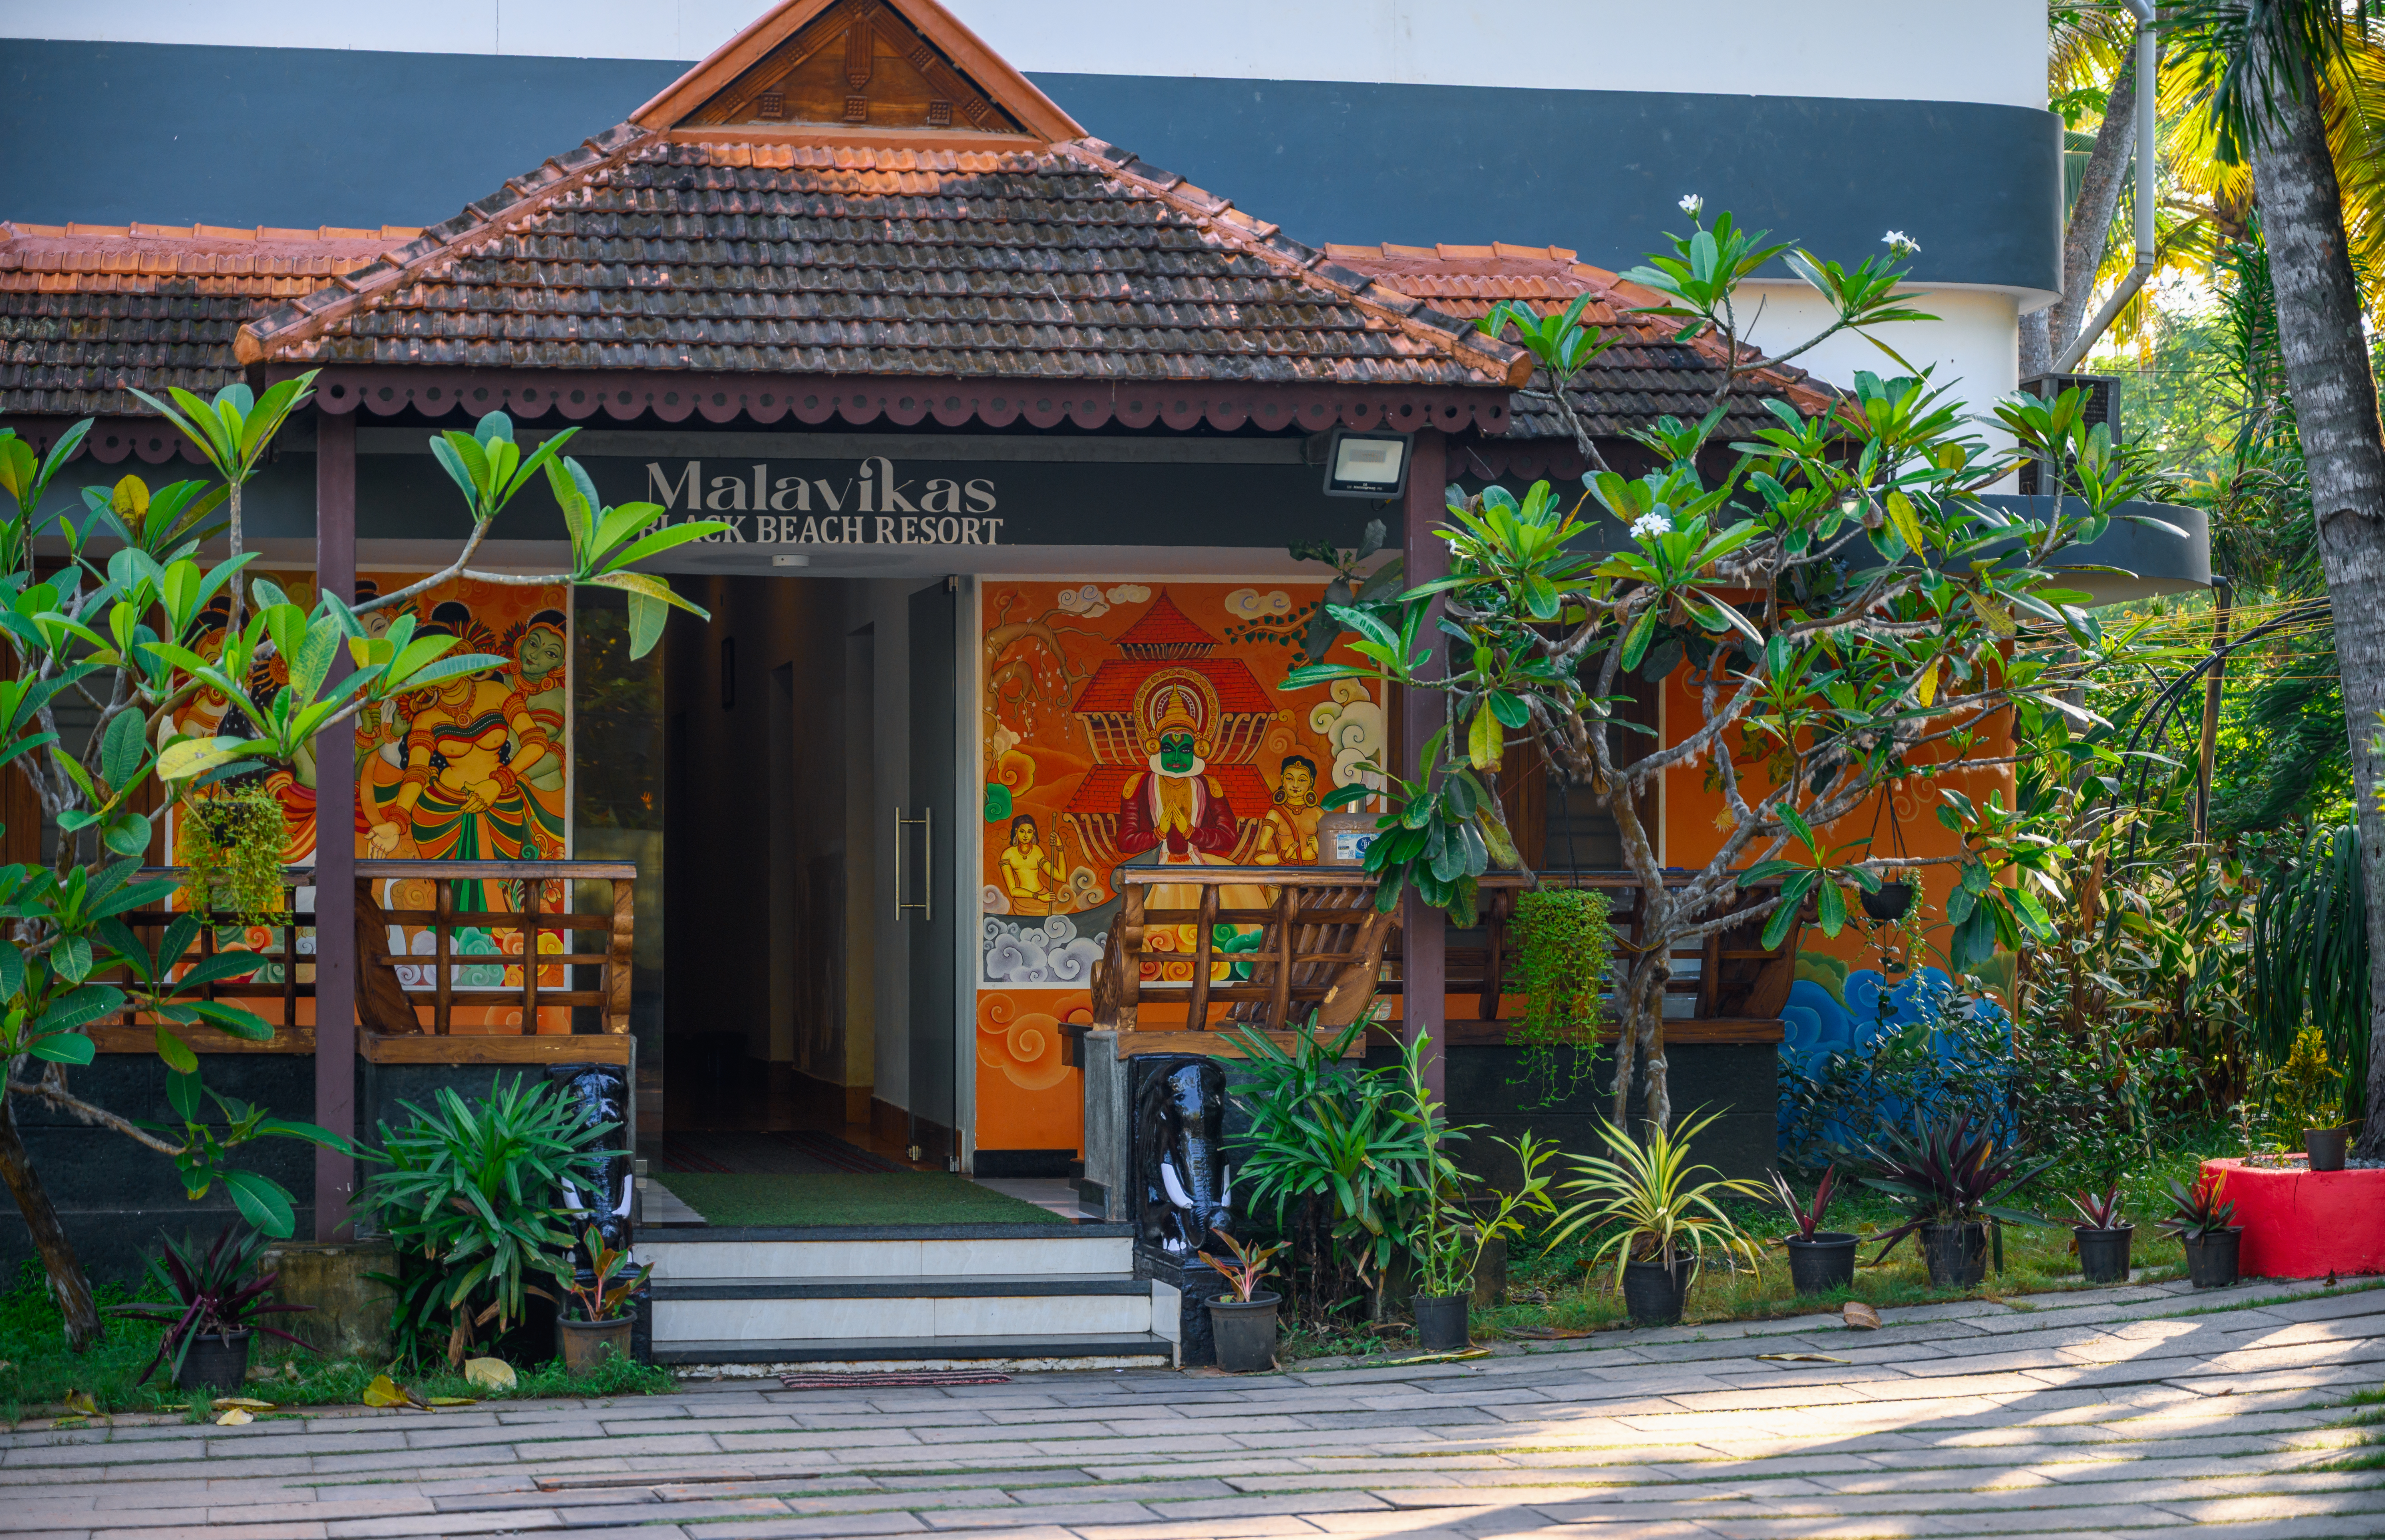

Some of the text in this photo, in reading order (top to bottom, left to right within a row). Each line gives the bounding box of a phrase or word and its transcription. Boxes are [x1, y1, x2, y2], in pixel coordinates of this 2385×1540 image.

[645, 456, 996, 513] Malavikas
[756, 516, 864, 543] BEACH
[875, 516, 1003, 545] RESORT
